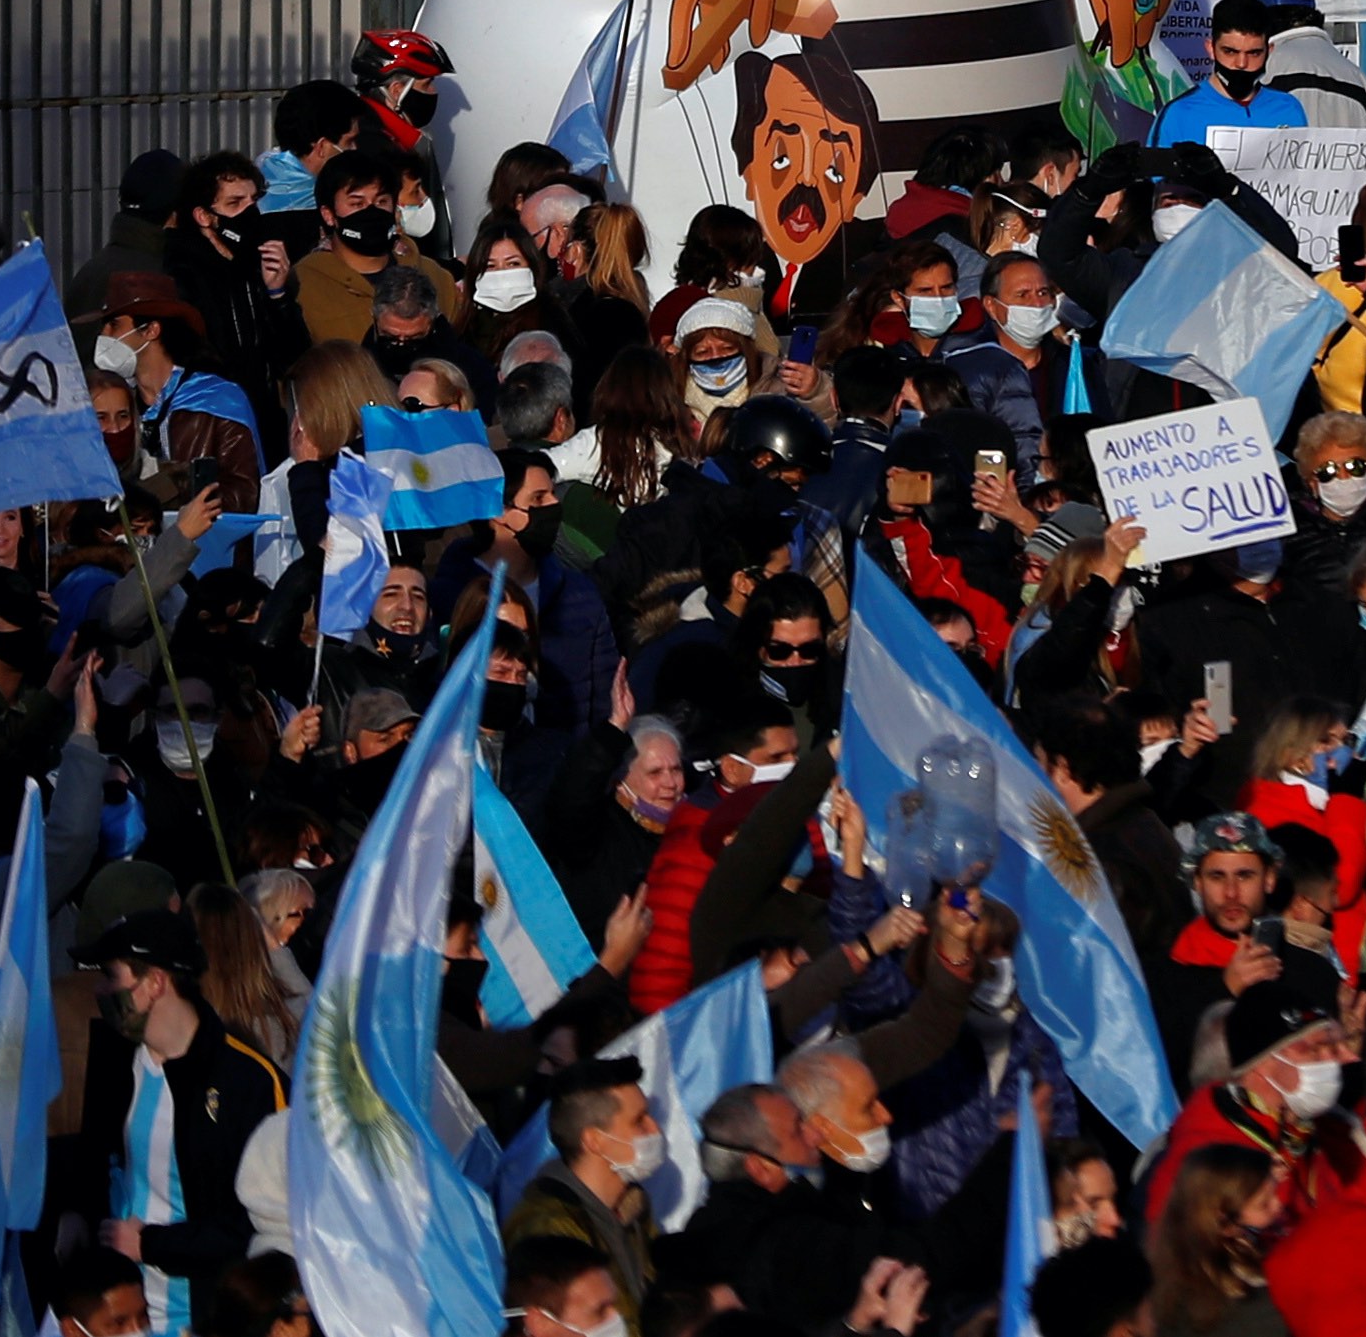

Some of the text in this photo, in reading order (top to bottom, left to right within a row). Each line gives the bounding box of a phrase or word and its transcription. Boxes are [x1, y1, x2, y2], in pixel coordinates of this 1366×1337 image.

[1174, 0, 1200, 12] VIDA
[1213, 129, 1257, 173] EL
[1103, 415, 1234, 460] AUMENTO A
[1103, 435, 1262, 489] TRABAJADORES
[1113, 471, 1287, 532] DE LA SALUD
